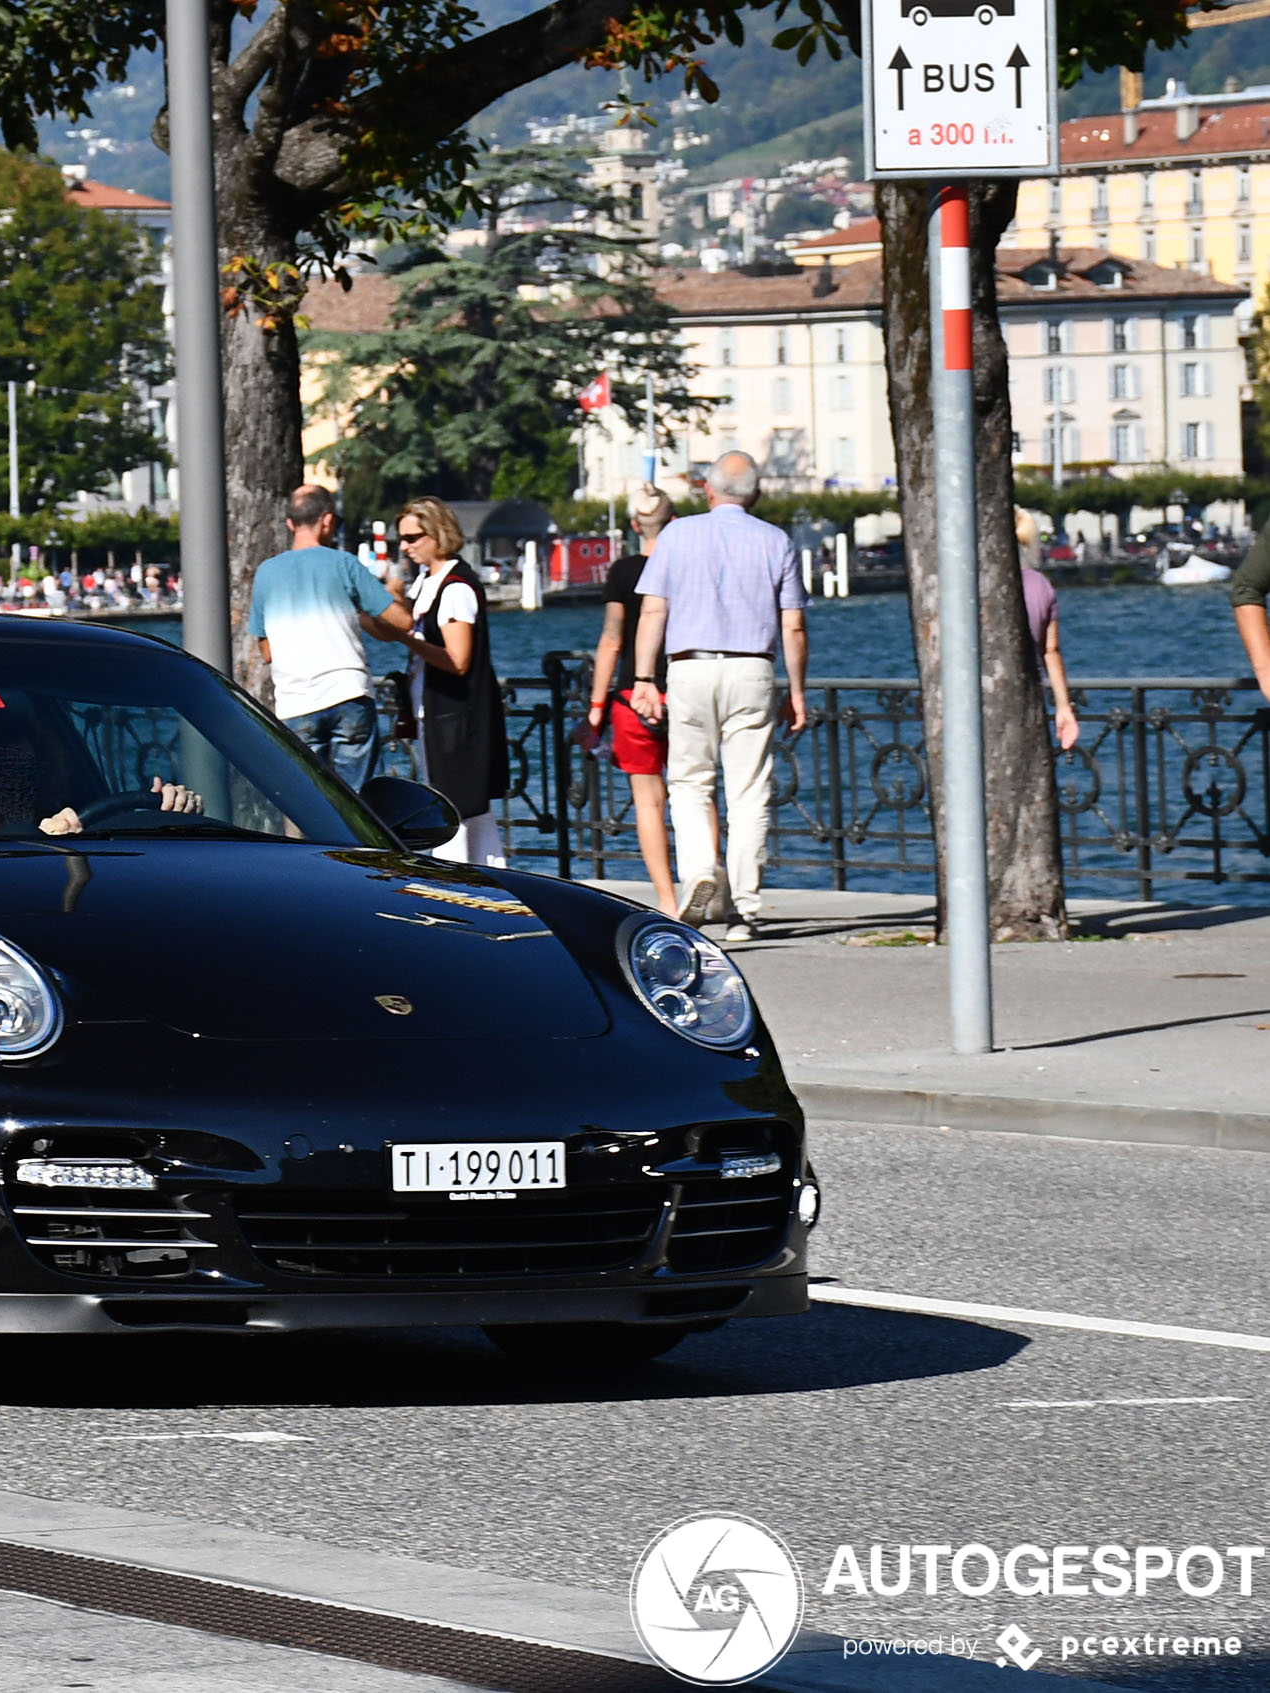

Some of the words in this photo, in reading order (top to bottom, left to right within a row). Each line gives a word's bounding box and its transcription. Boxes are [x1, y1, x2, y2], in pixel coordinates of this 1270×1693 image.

[923, 63, 994, 93] BUS
[908, 128, 921, 145] a
[930, 123, 974, 145] 300
